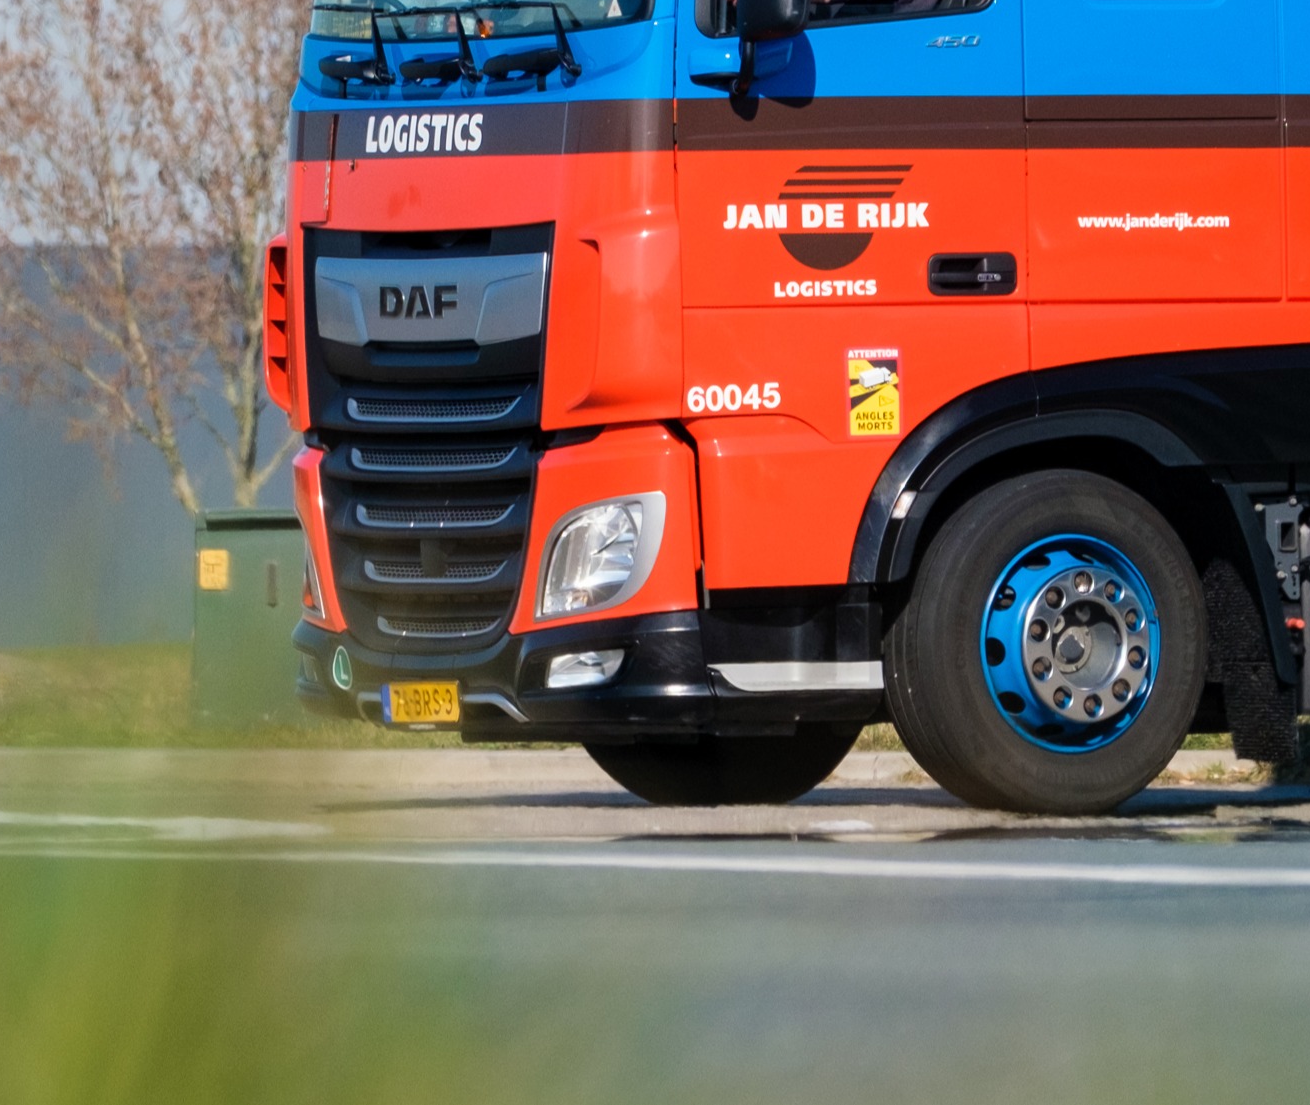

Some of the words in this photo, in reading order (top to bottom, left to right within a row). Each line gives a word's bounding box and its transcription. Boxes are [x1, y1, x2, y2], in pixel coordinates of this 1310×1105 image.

[365, 113, 484, 154] LOGISTICS
[723, 203, 788, 229] JAN
[801, 204, 845, 228] DE
[857, 202, 930, 229] RIJK
[1077, 212, 1230, 232] www.janderijk.com
[774, 280, 878, 297] LOGISTICS
[379, 284, 458, 320] DAF
[848, 349, 898, 358] ATTENTION
[686, 382, 782, 413] 60045
[855, 411, 894, 421] ANGLES
[857, 422, 893, 431] MORTS
